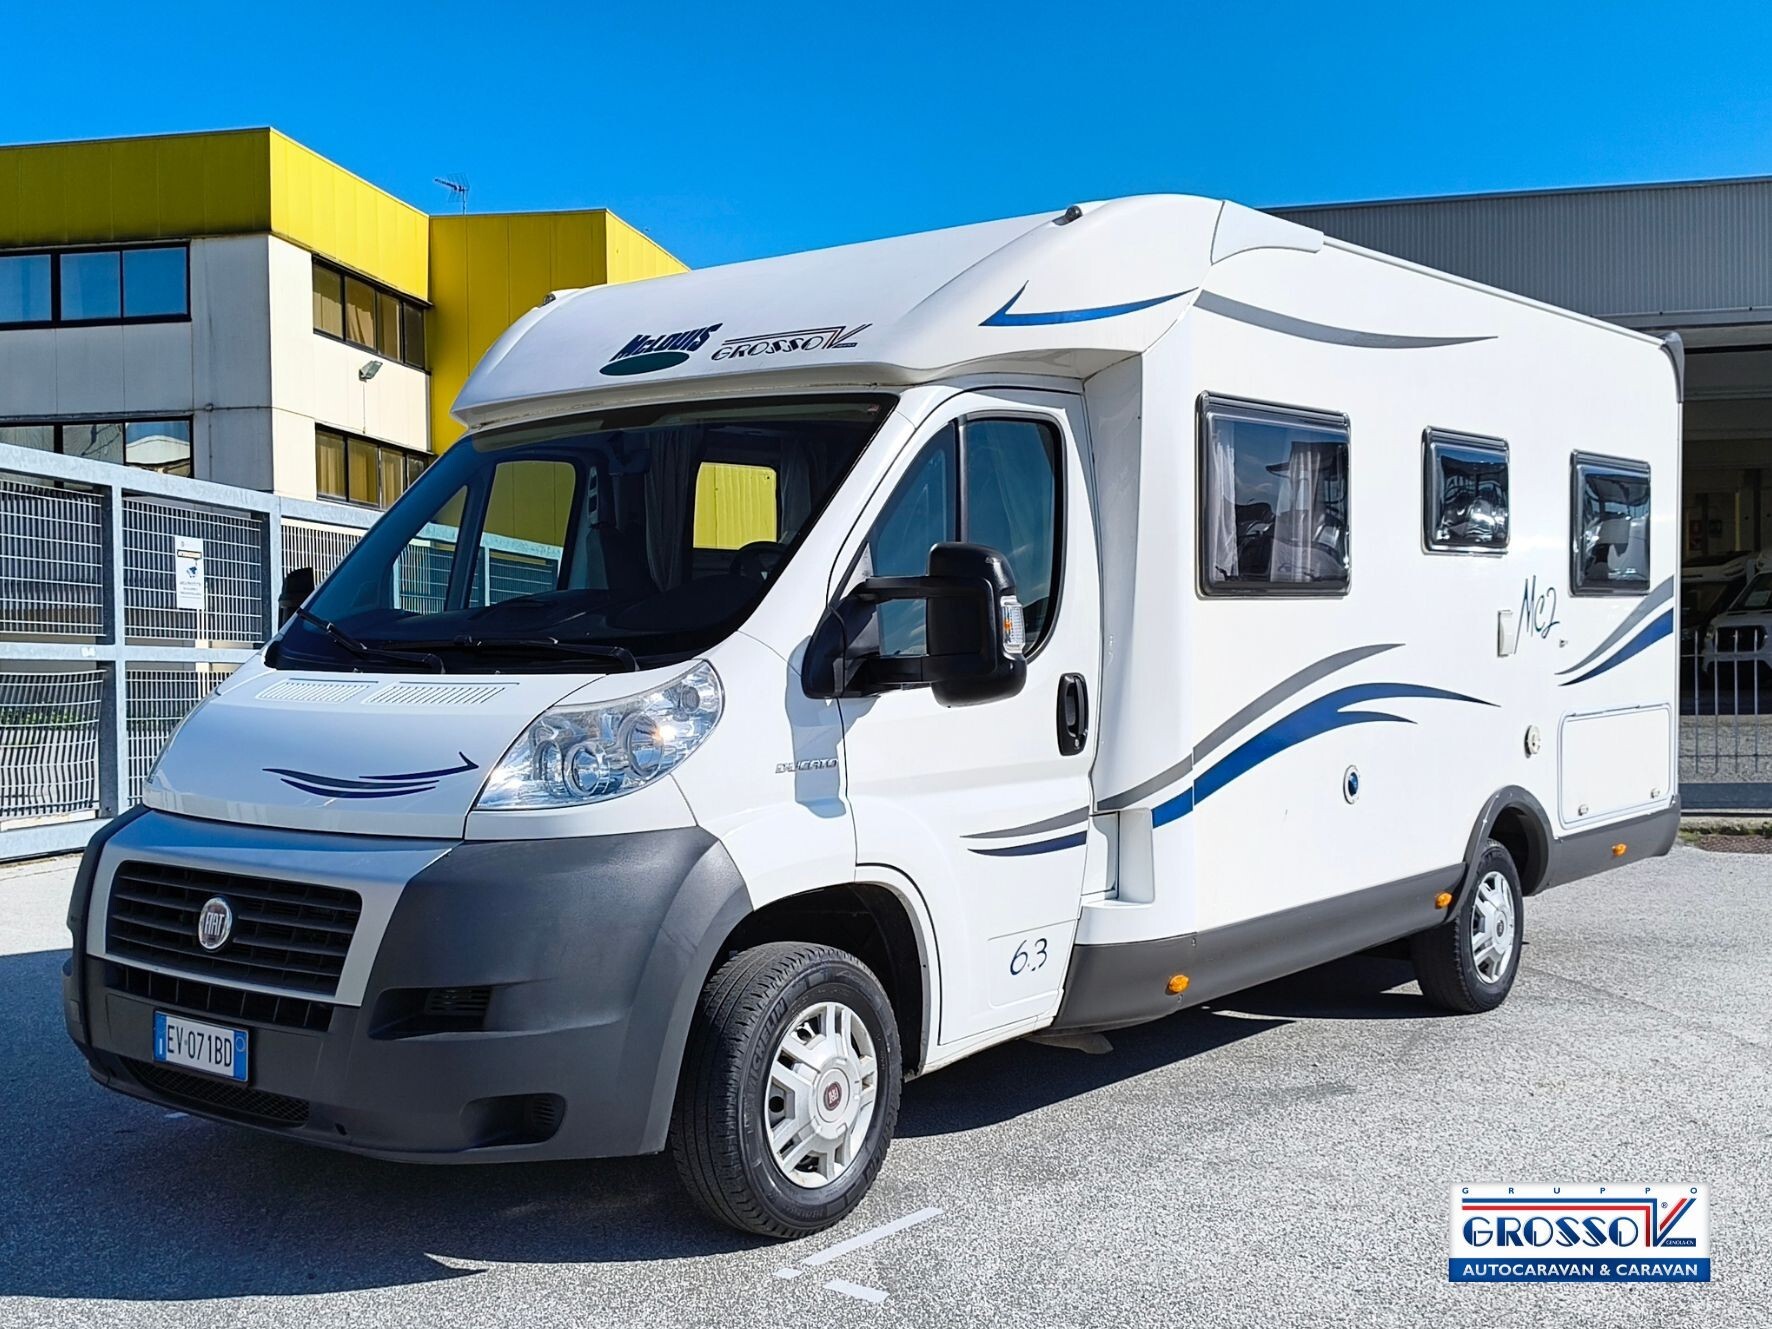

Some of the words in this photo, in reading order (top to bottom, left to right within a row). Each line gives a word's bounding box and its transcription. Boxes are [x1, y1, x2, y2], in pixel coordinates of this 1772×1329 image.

[711, 336, 824, 361] GROSSO
[204, 912, 225, 935] FIAT
[1010, 937, 1048, 976] 6.3
[747, 996, 788, 1093] MICHELIN
